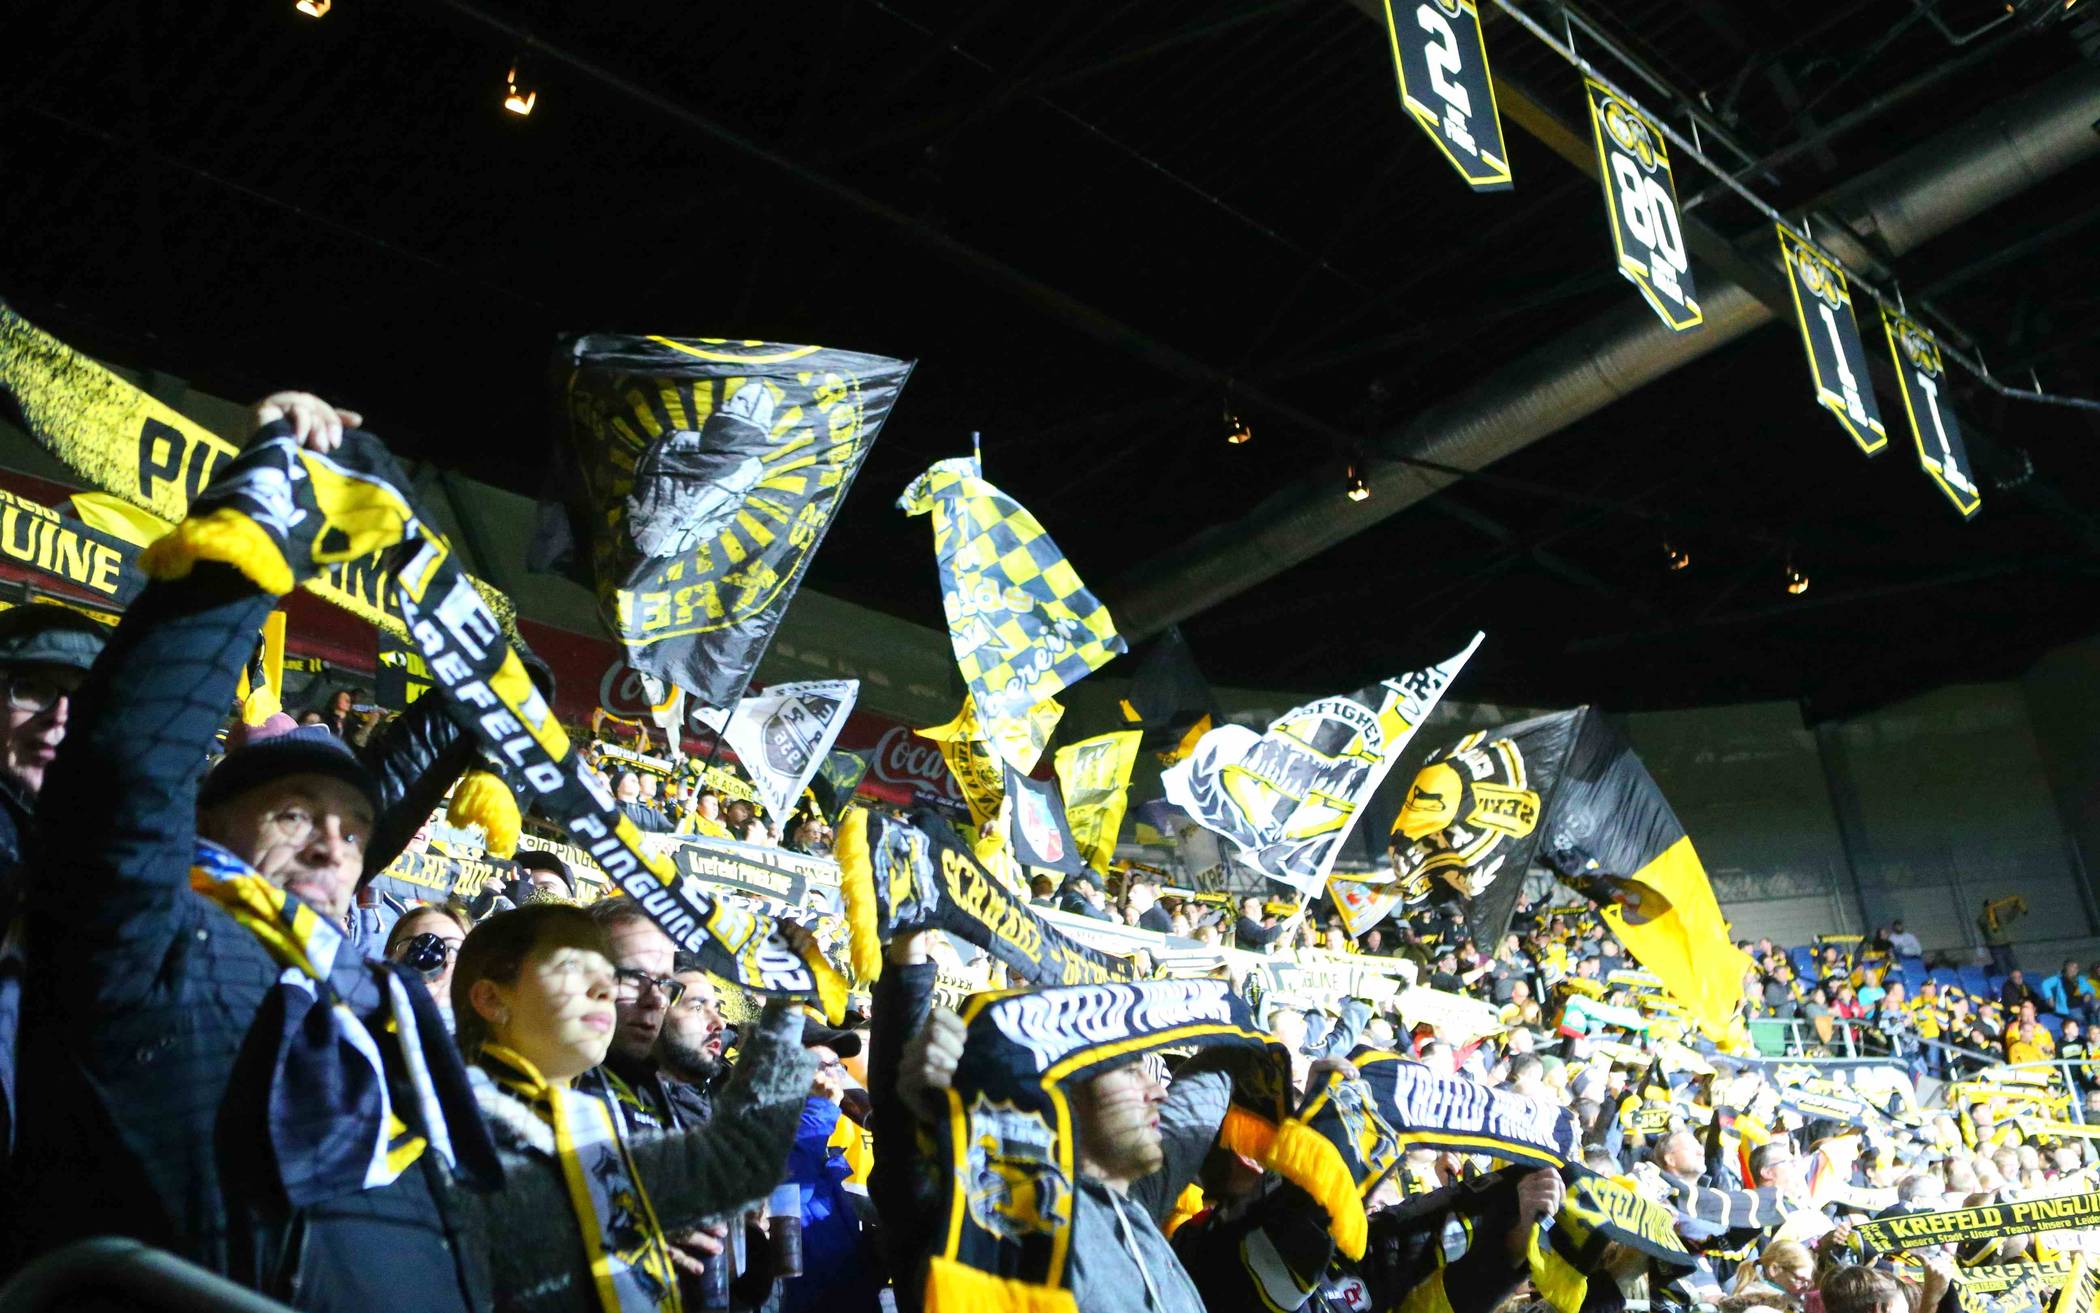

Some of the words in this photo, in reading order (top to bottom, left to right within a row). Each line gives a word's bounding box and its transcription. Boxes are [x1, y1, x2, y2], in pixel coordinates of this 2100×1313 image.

[1416, 3, 1472, 118] 2
[1611, 151, 1688, 274] 80
[1818, 302, 1857, 392] 1
[570, 812, 709, 954] PINGUINE
[1394, 1063, 1490, 1132] KREFELD
[1889, 1207, 2003, 1239] KREFELD
[1901, 1236, 1936, 1249] Unsere
[1938, 1232, 1964, 1244] Stadt
[1970, 1228, 1999, 1240] Unser
[2002, 1225, 2031, 1237] Team
[2037, 1219, 2072, 1231] Unsere
